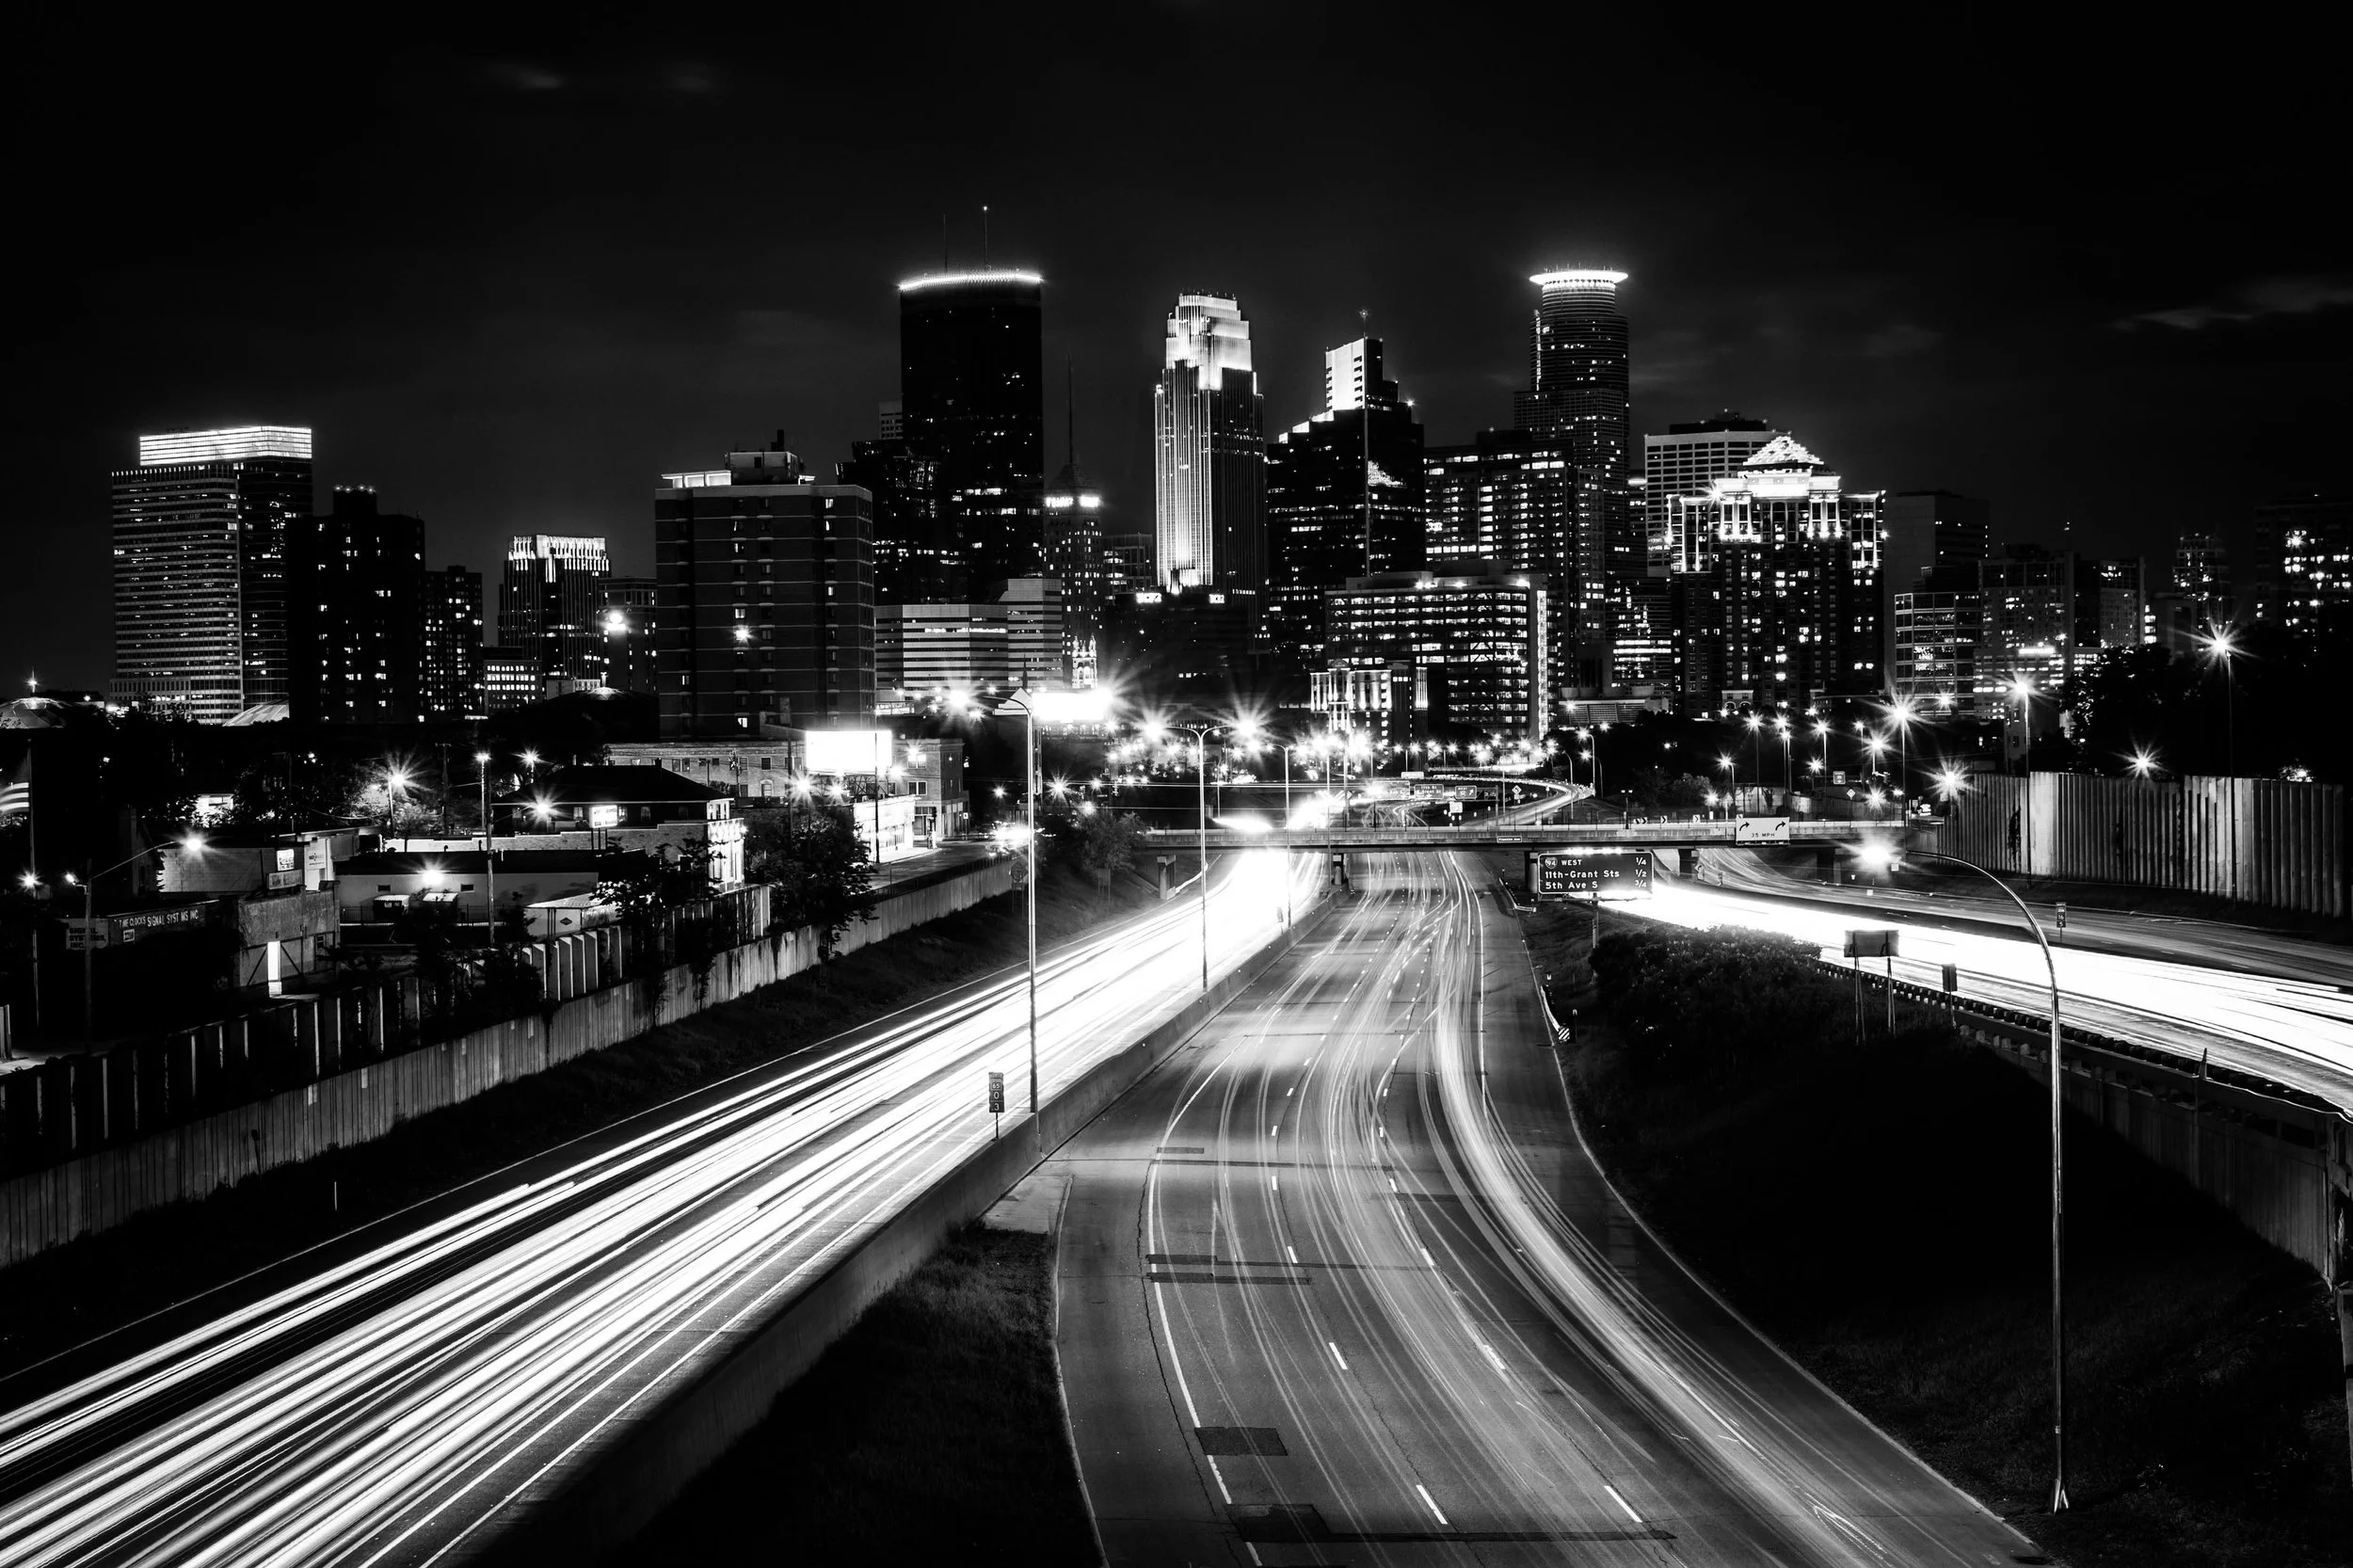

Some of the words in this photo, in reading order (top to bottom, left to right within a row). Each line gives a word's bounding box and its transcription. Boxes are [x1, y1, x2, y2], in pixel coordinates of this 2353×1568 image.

[1636, 856, 1647, 866] 1/4
[1545, 871, 1598, 879] 11th-Grant
[1603, 870, 1620, 878] Sts
[1635, 869, 1647, 878] 1/2
[1545, 881, 1562, 889] 5th
[1568, 881, 1587, 889] Ave
[1634, 879, 1647, 888] 3/4
[129, 916, 146, 926] CLOCKS
[147, 915, 165, 927] SIGNAL
[993, 1091, 1000, 1099] 0
